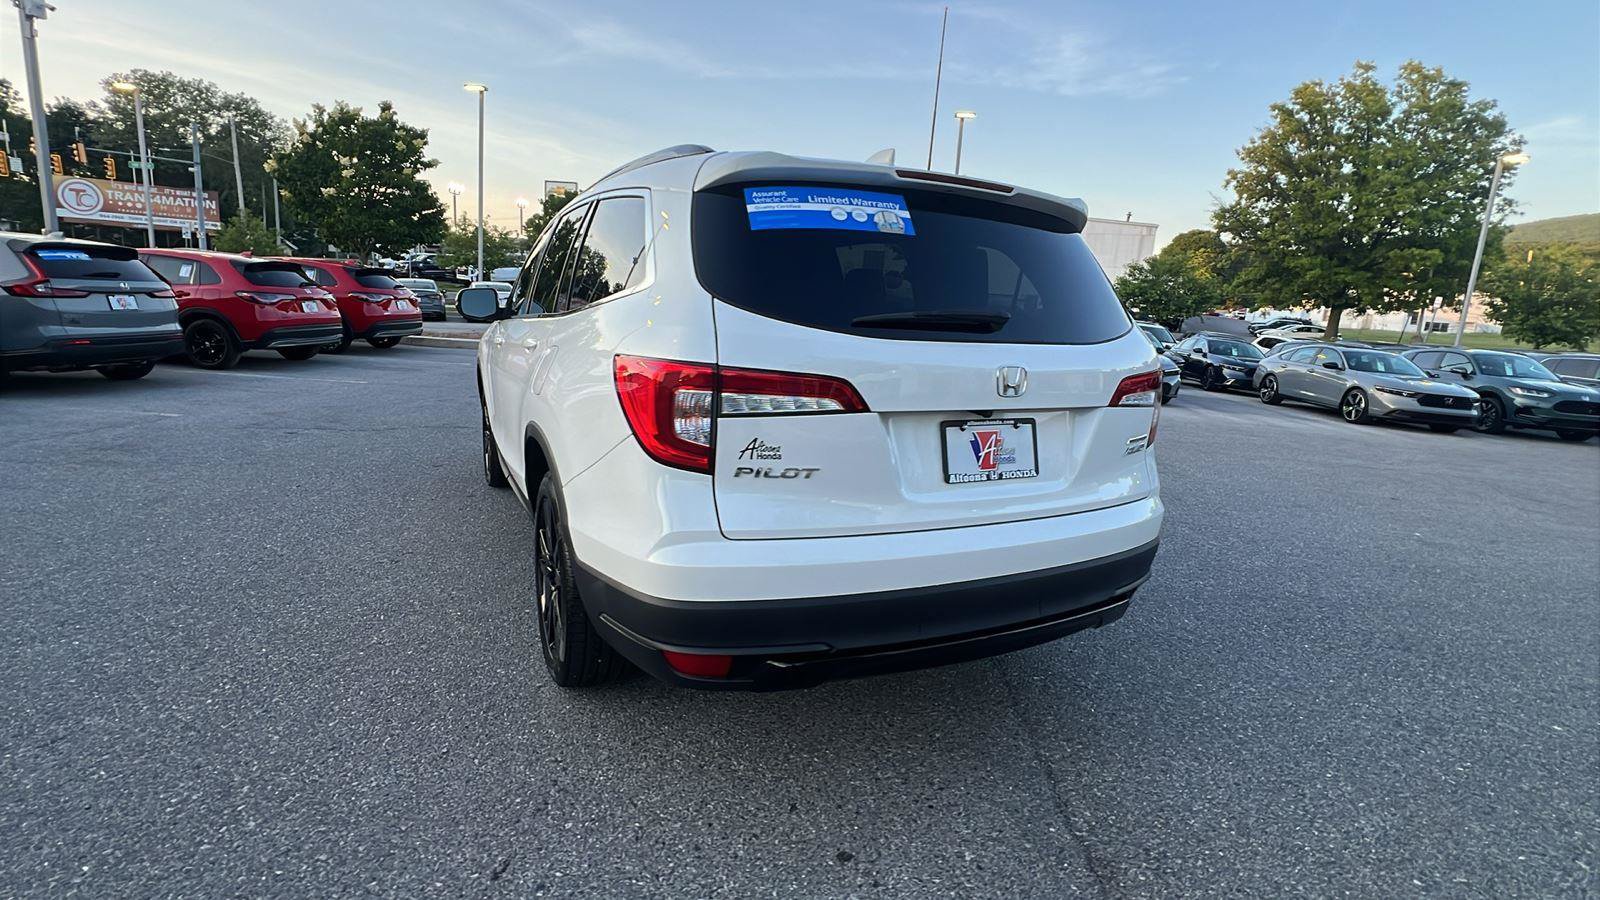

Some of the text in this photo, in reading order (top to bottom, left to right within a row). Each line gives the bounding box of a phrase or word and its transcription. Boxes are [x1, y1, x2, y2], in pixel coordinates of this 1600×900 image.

[752, 190, 787, 198] Assurant
[807, 195, 900, 212] Limited Warranty
[733, 466, 820, 480] PILOT
[948, 473, 988, 484] Altoona
[1002, 469, 1037, 479] HONDA
